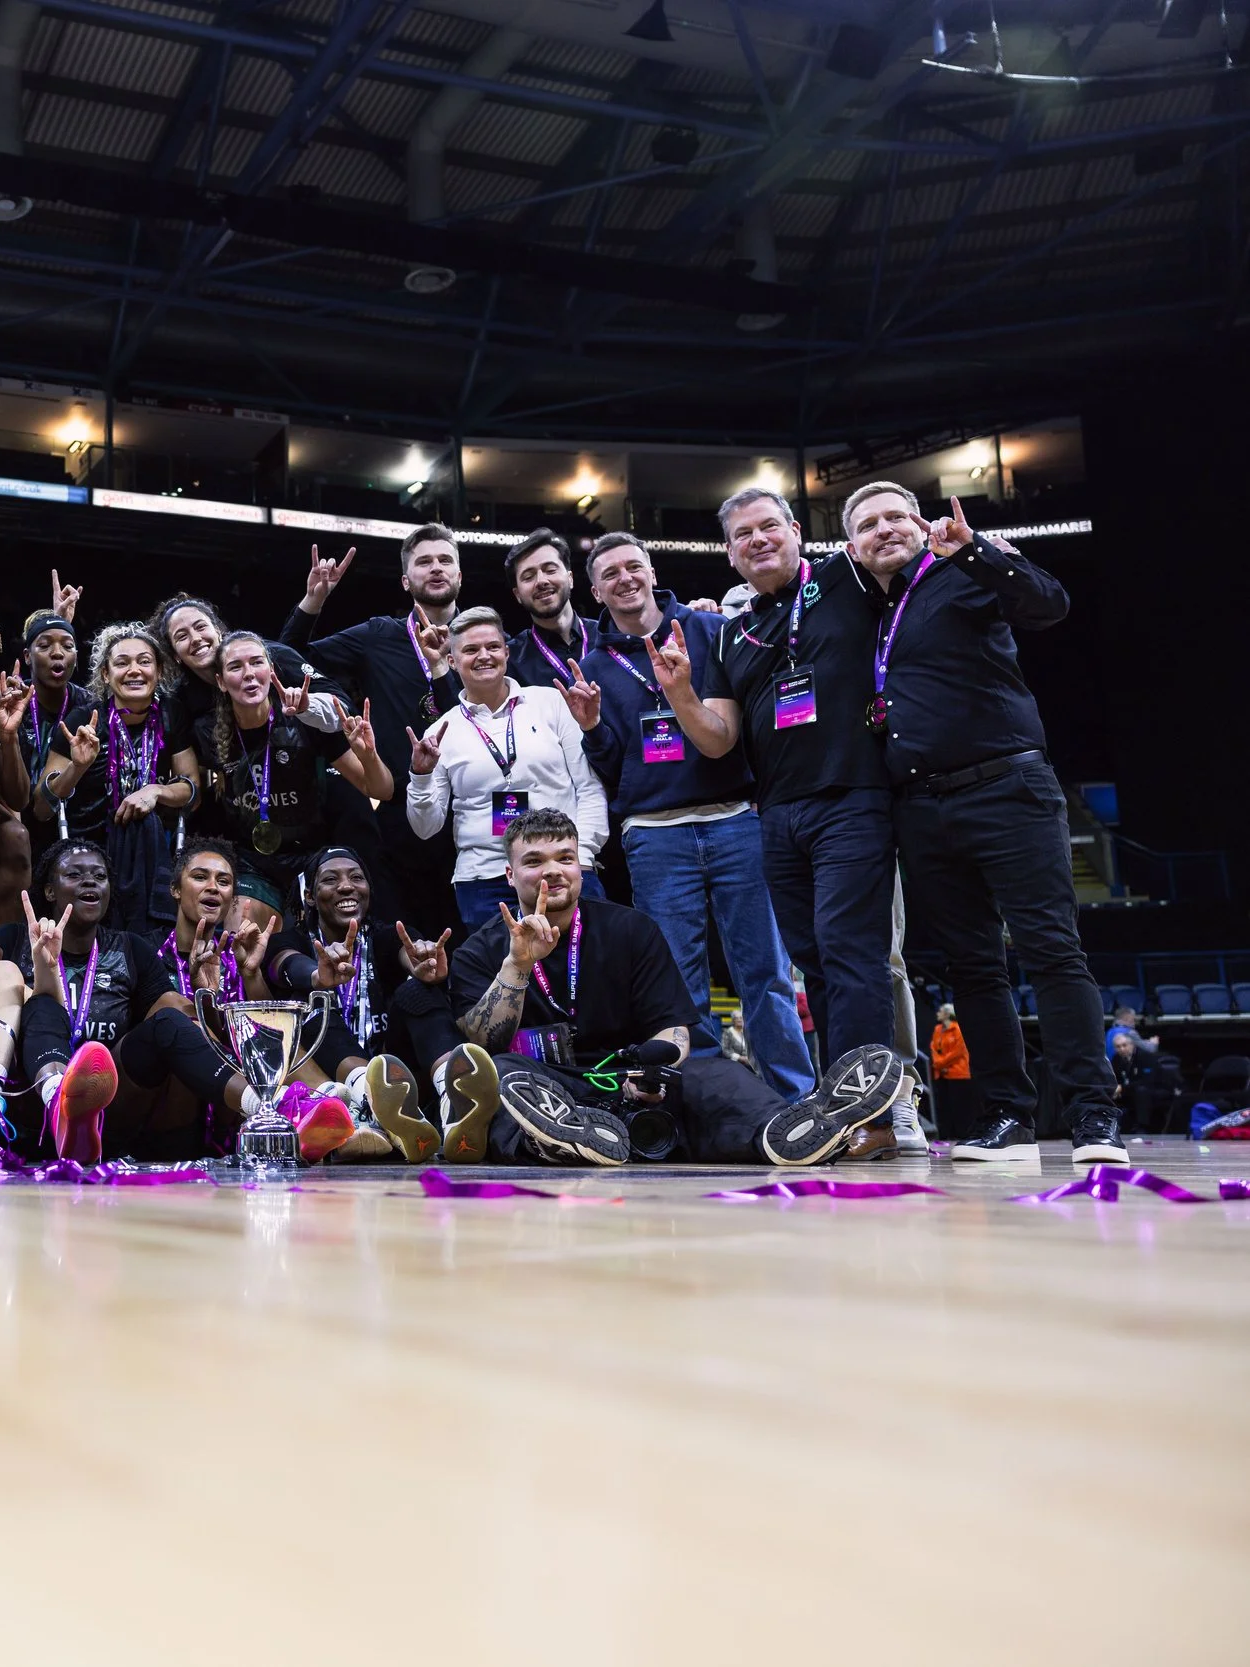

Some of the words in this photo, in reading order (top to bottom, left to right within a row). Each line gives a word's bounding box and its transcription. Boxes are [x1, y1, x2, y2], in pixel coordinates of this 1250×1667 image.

[805, 540, 849, 553] FOLLO
[789, 607, 802, 630] SUPER
[760, 637, 774, 652] CUP
[615, 652, 633, 670] LEAGUE
[630, 667, 646, 683] SUPER
[487, 741, 498, 753] CUP
[506, 735, 515, 754] SUPER
[655, 742, 672, 750] VIP
[252, 764, 263, 787] 6
[570, 944, 578, 973] LEAGUE
[532, 961, 551, 994] KETBALL
[547, 994, 559, 1010] CUP
[77, 1011, 85, 1026] Super
[84, 970, 94, 993] Basketball
